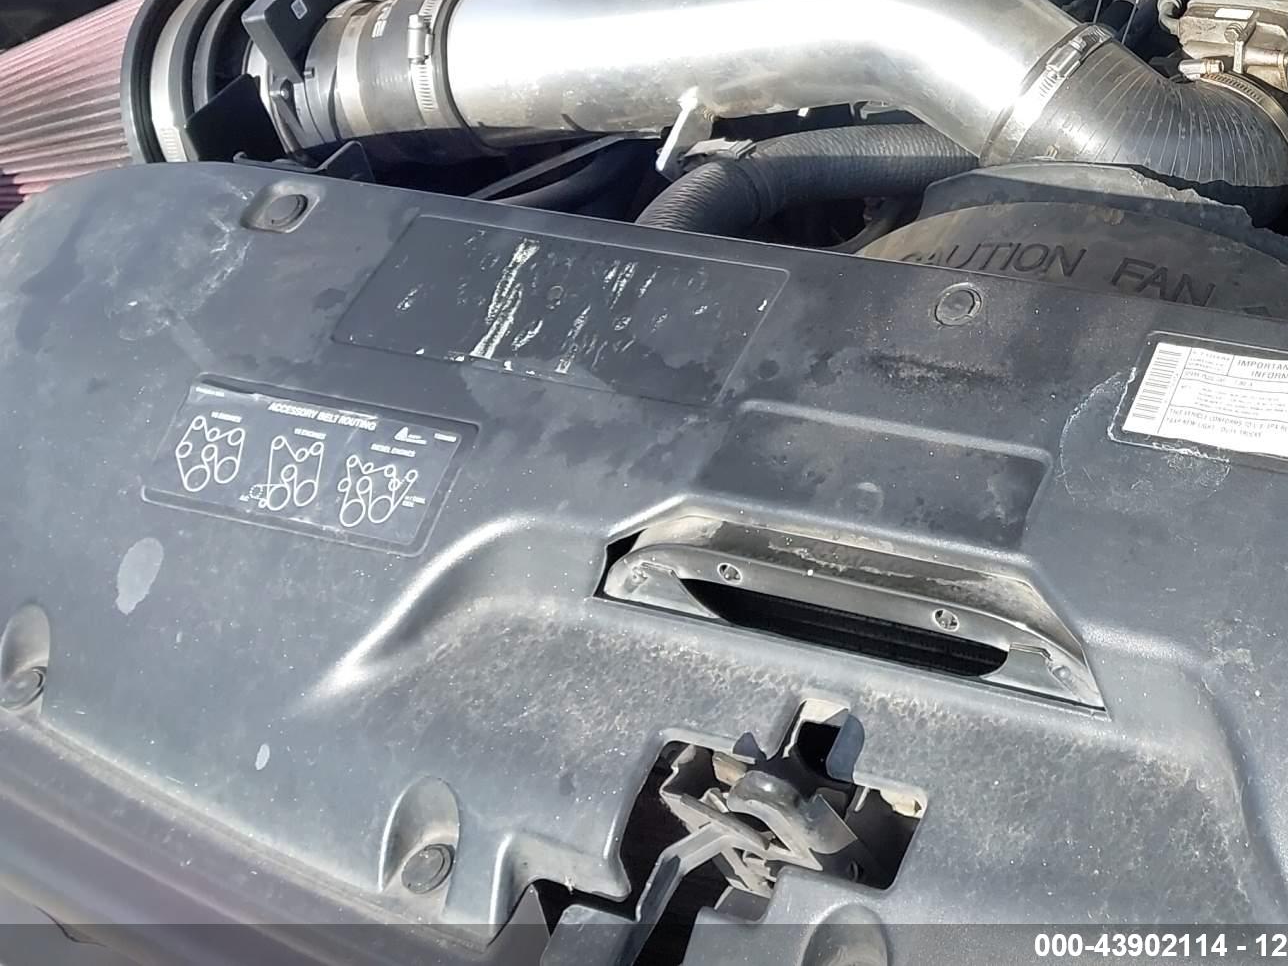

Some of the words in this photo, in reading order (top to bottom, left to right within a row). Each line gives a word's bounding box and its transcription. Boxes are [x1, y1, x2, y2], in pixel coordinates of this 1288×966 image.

[900, 242, 1088, 277] UTION
[1111, 257, 1216, 307] FAN
[267, 402, 319, 419] ACCESSORY
[316, 411, 340, 424] BELT
[337, 415, 377, 432] ROUTING
